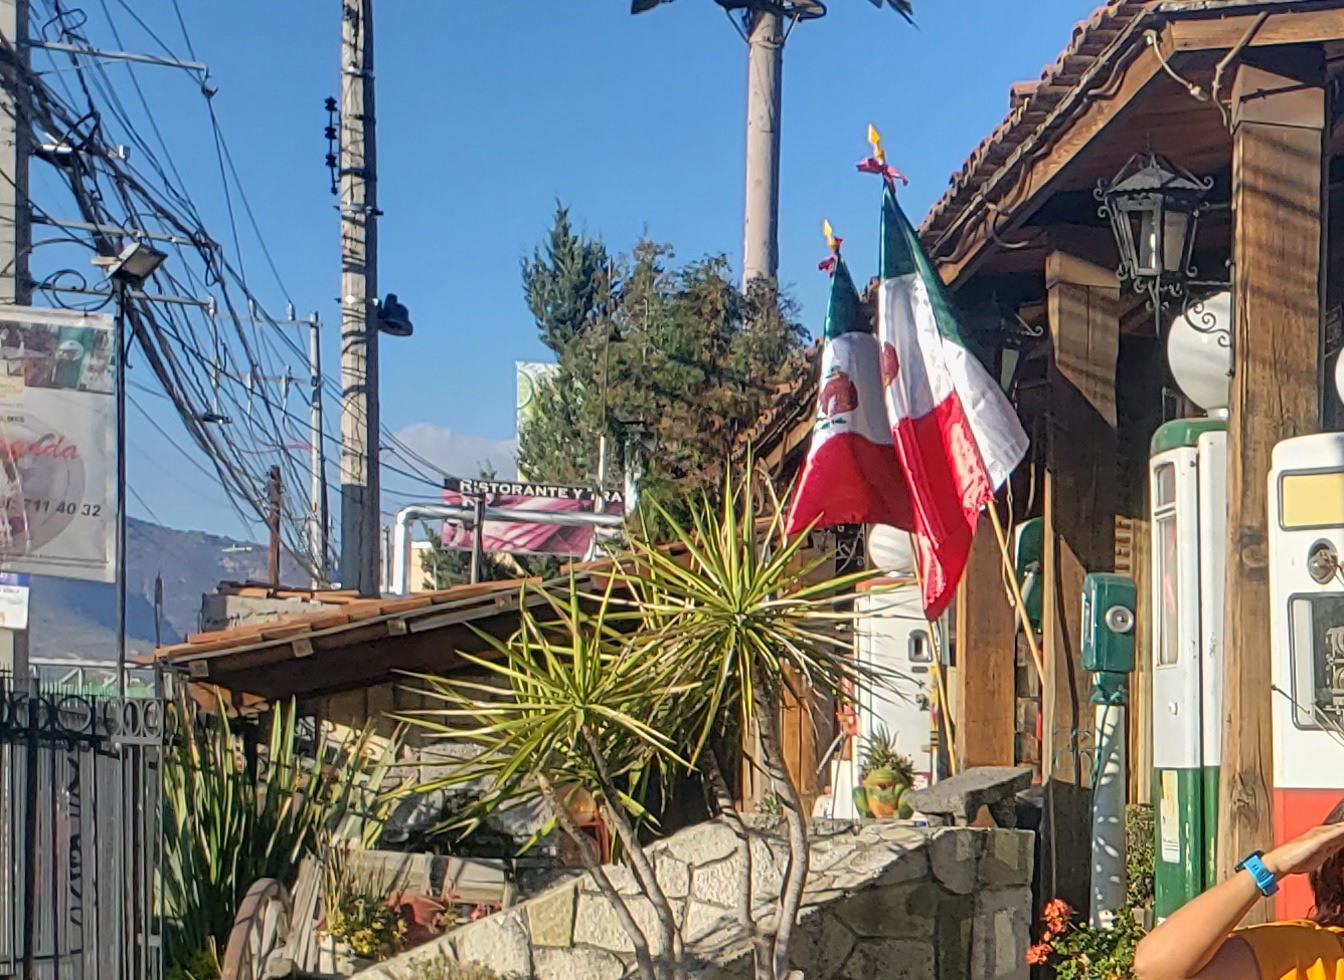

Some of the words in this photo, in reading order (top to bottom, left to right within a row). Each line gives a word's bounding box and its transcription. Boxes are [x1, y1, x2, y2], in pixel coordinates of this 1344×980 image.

[459, 479, 569, 499] RISTORANTE
[573, 488, 584, 500] Y
[56, 501, 77, 515] 40
[82, 504, 101, 517] 32
